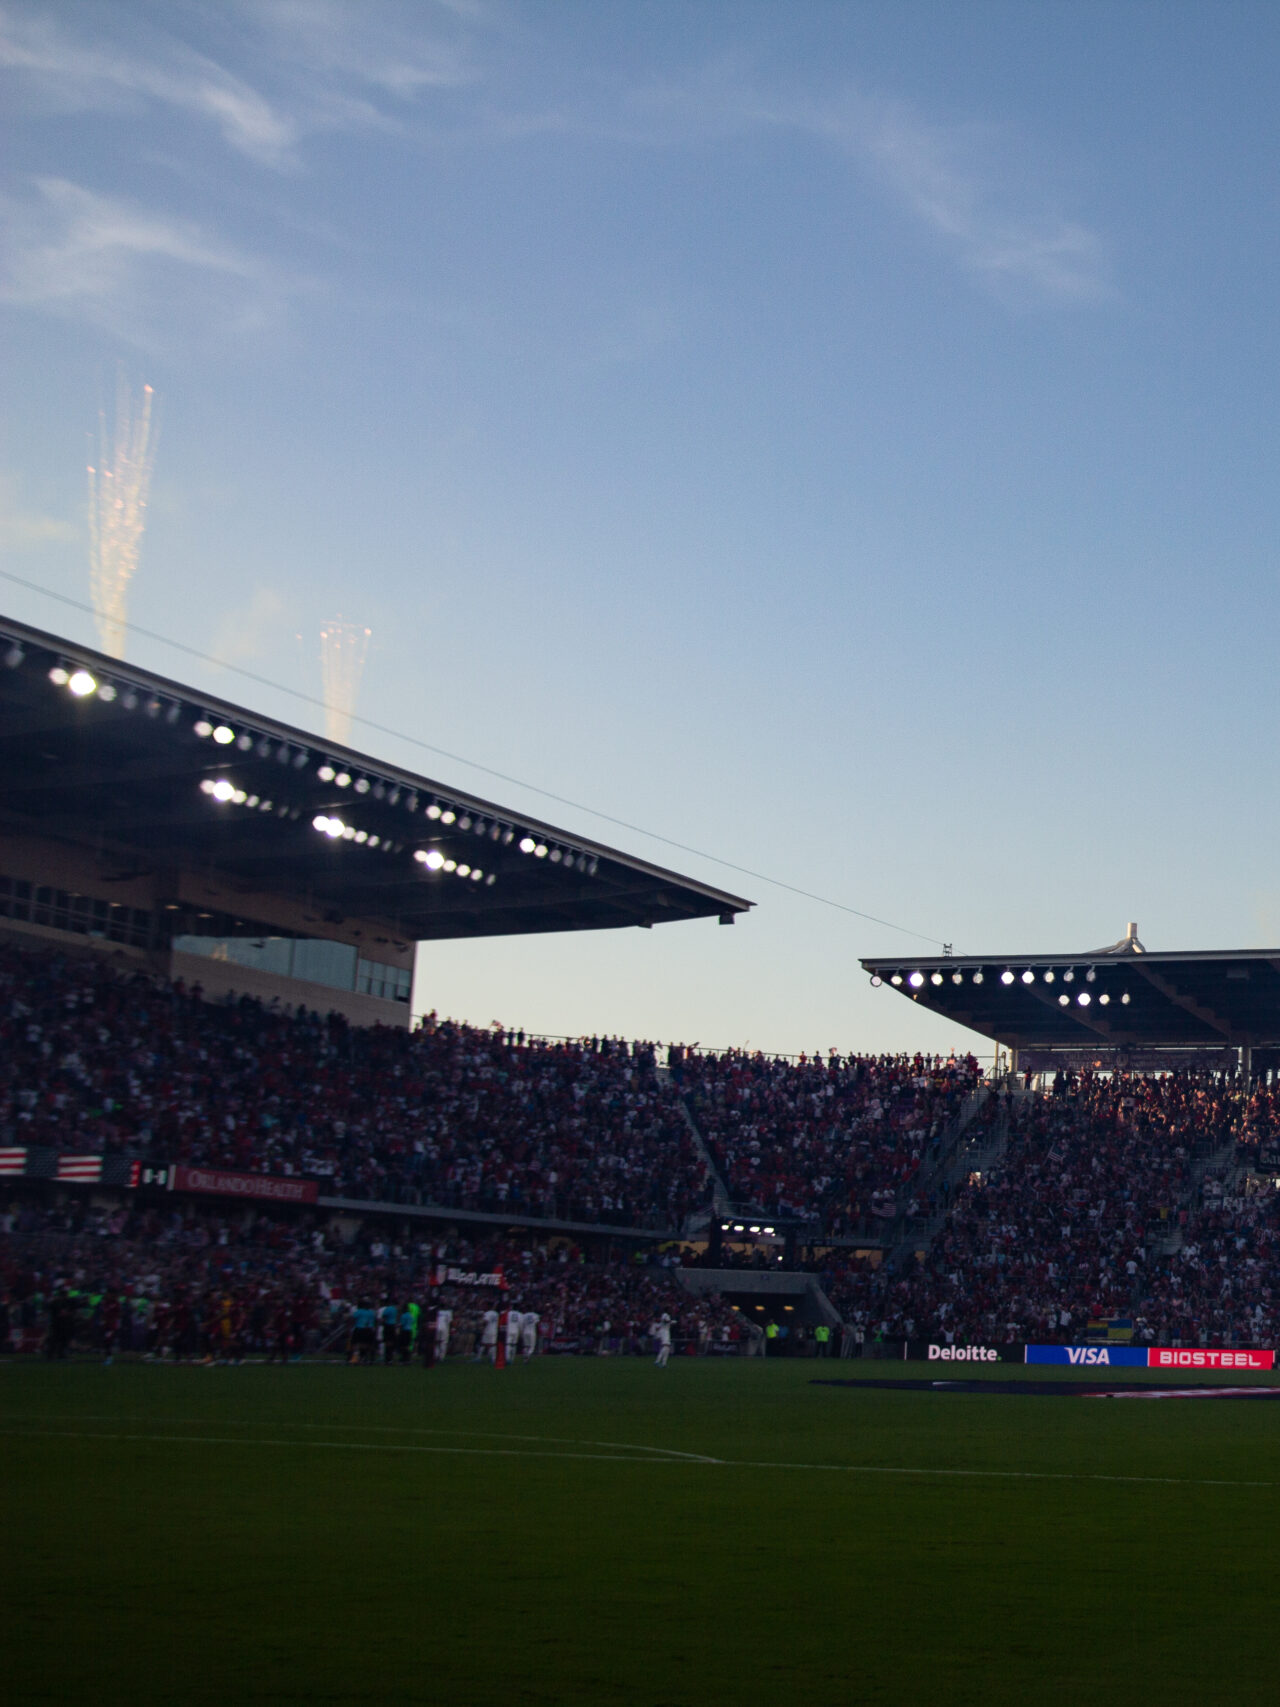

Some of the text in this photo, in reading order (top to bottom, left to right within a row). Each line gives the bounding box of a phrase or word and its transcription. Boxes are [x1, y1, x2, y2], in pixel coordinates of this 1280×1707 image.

[187, 1171, 251, 1195] ORLANDO
[250, 1180, 304, 1199] HEALTH
[1064, 1347, 1110, 1364] VISA
[1160, 1351, 1261, 1367] BIOSTEEL
